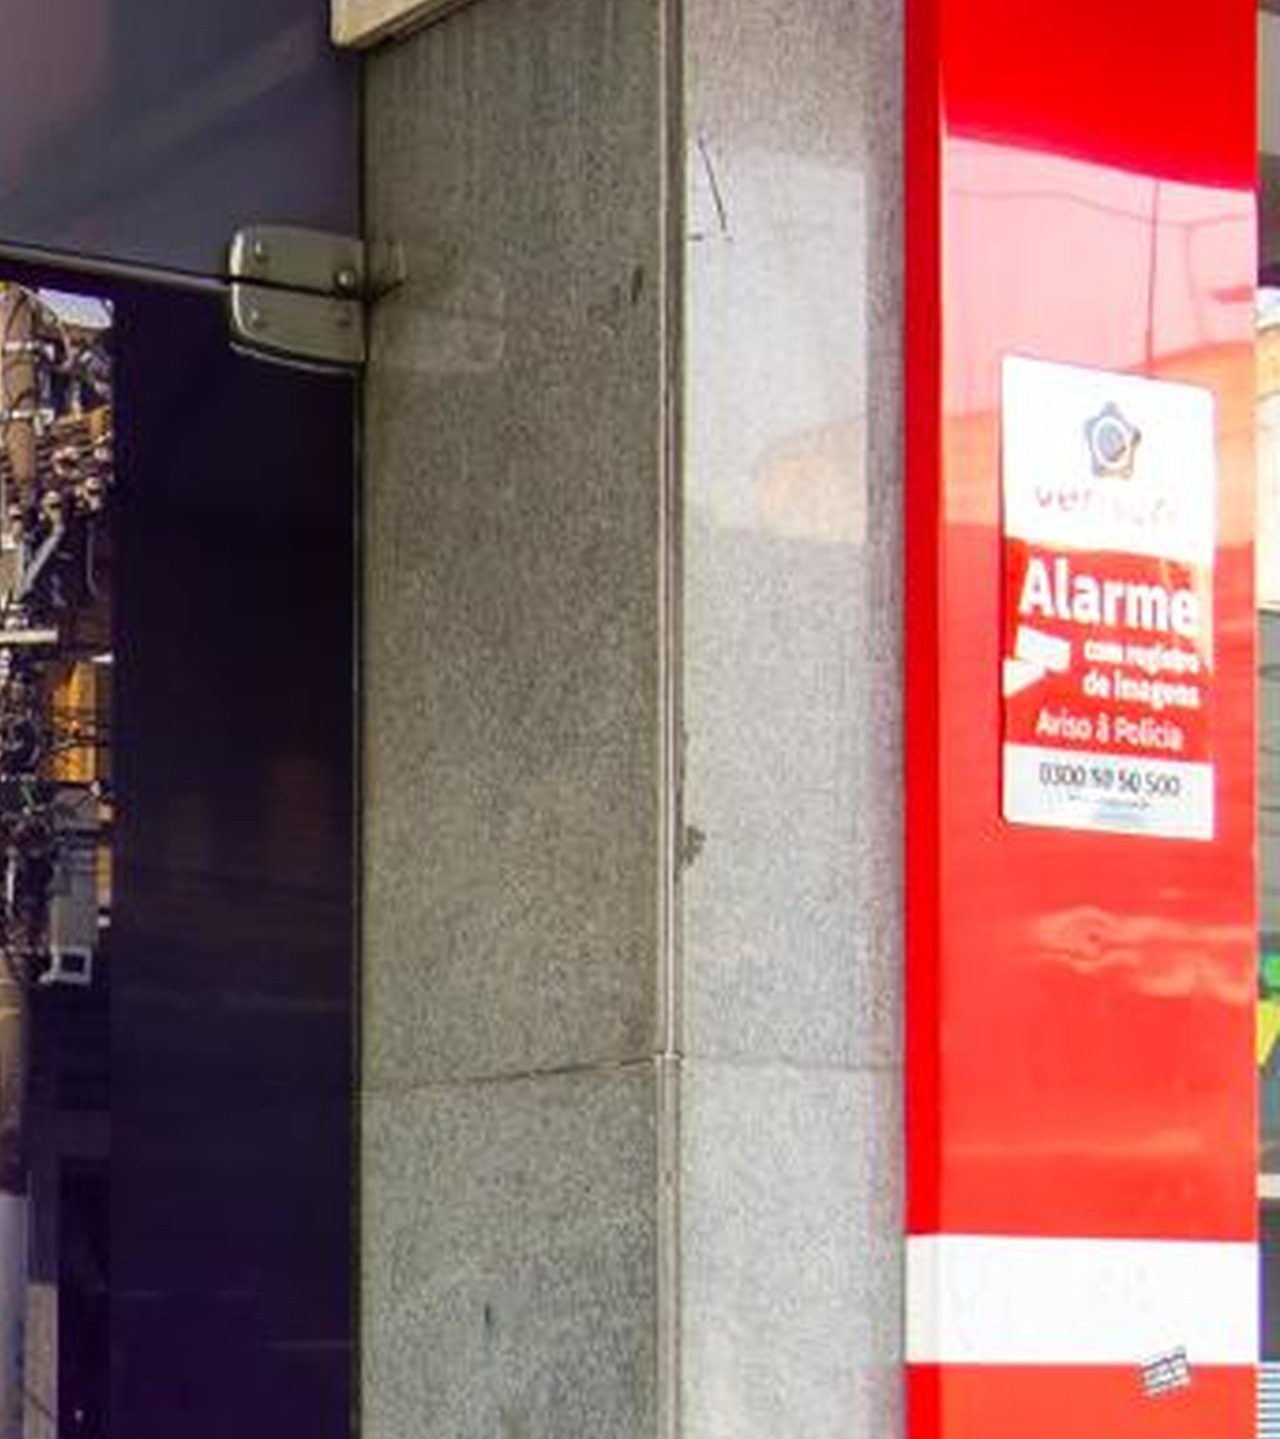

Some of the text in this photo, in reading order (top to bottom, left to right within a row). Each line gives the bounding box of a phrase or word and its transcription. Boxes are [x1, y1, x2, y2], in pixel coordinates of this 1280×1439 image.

[1019, 556, 1203, 638] Alarme
[1082, 668, 1111, 700] de
[1039, 760, 1087, 788] 0300
[1144, 770, 1182, 798] 500
